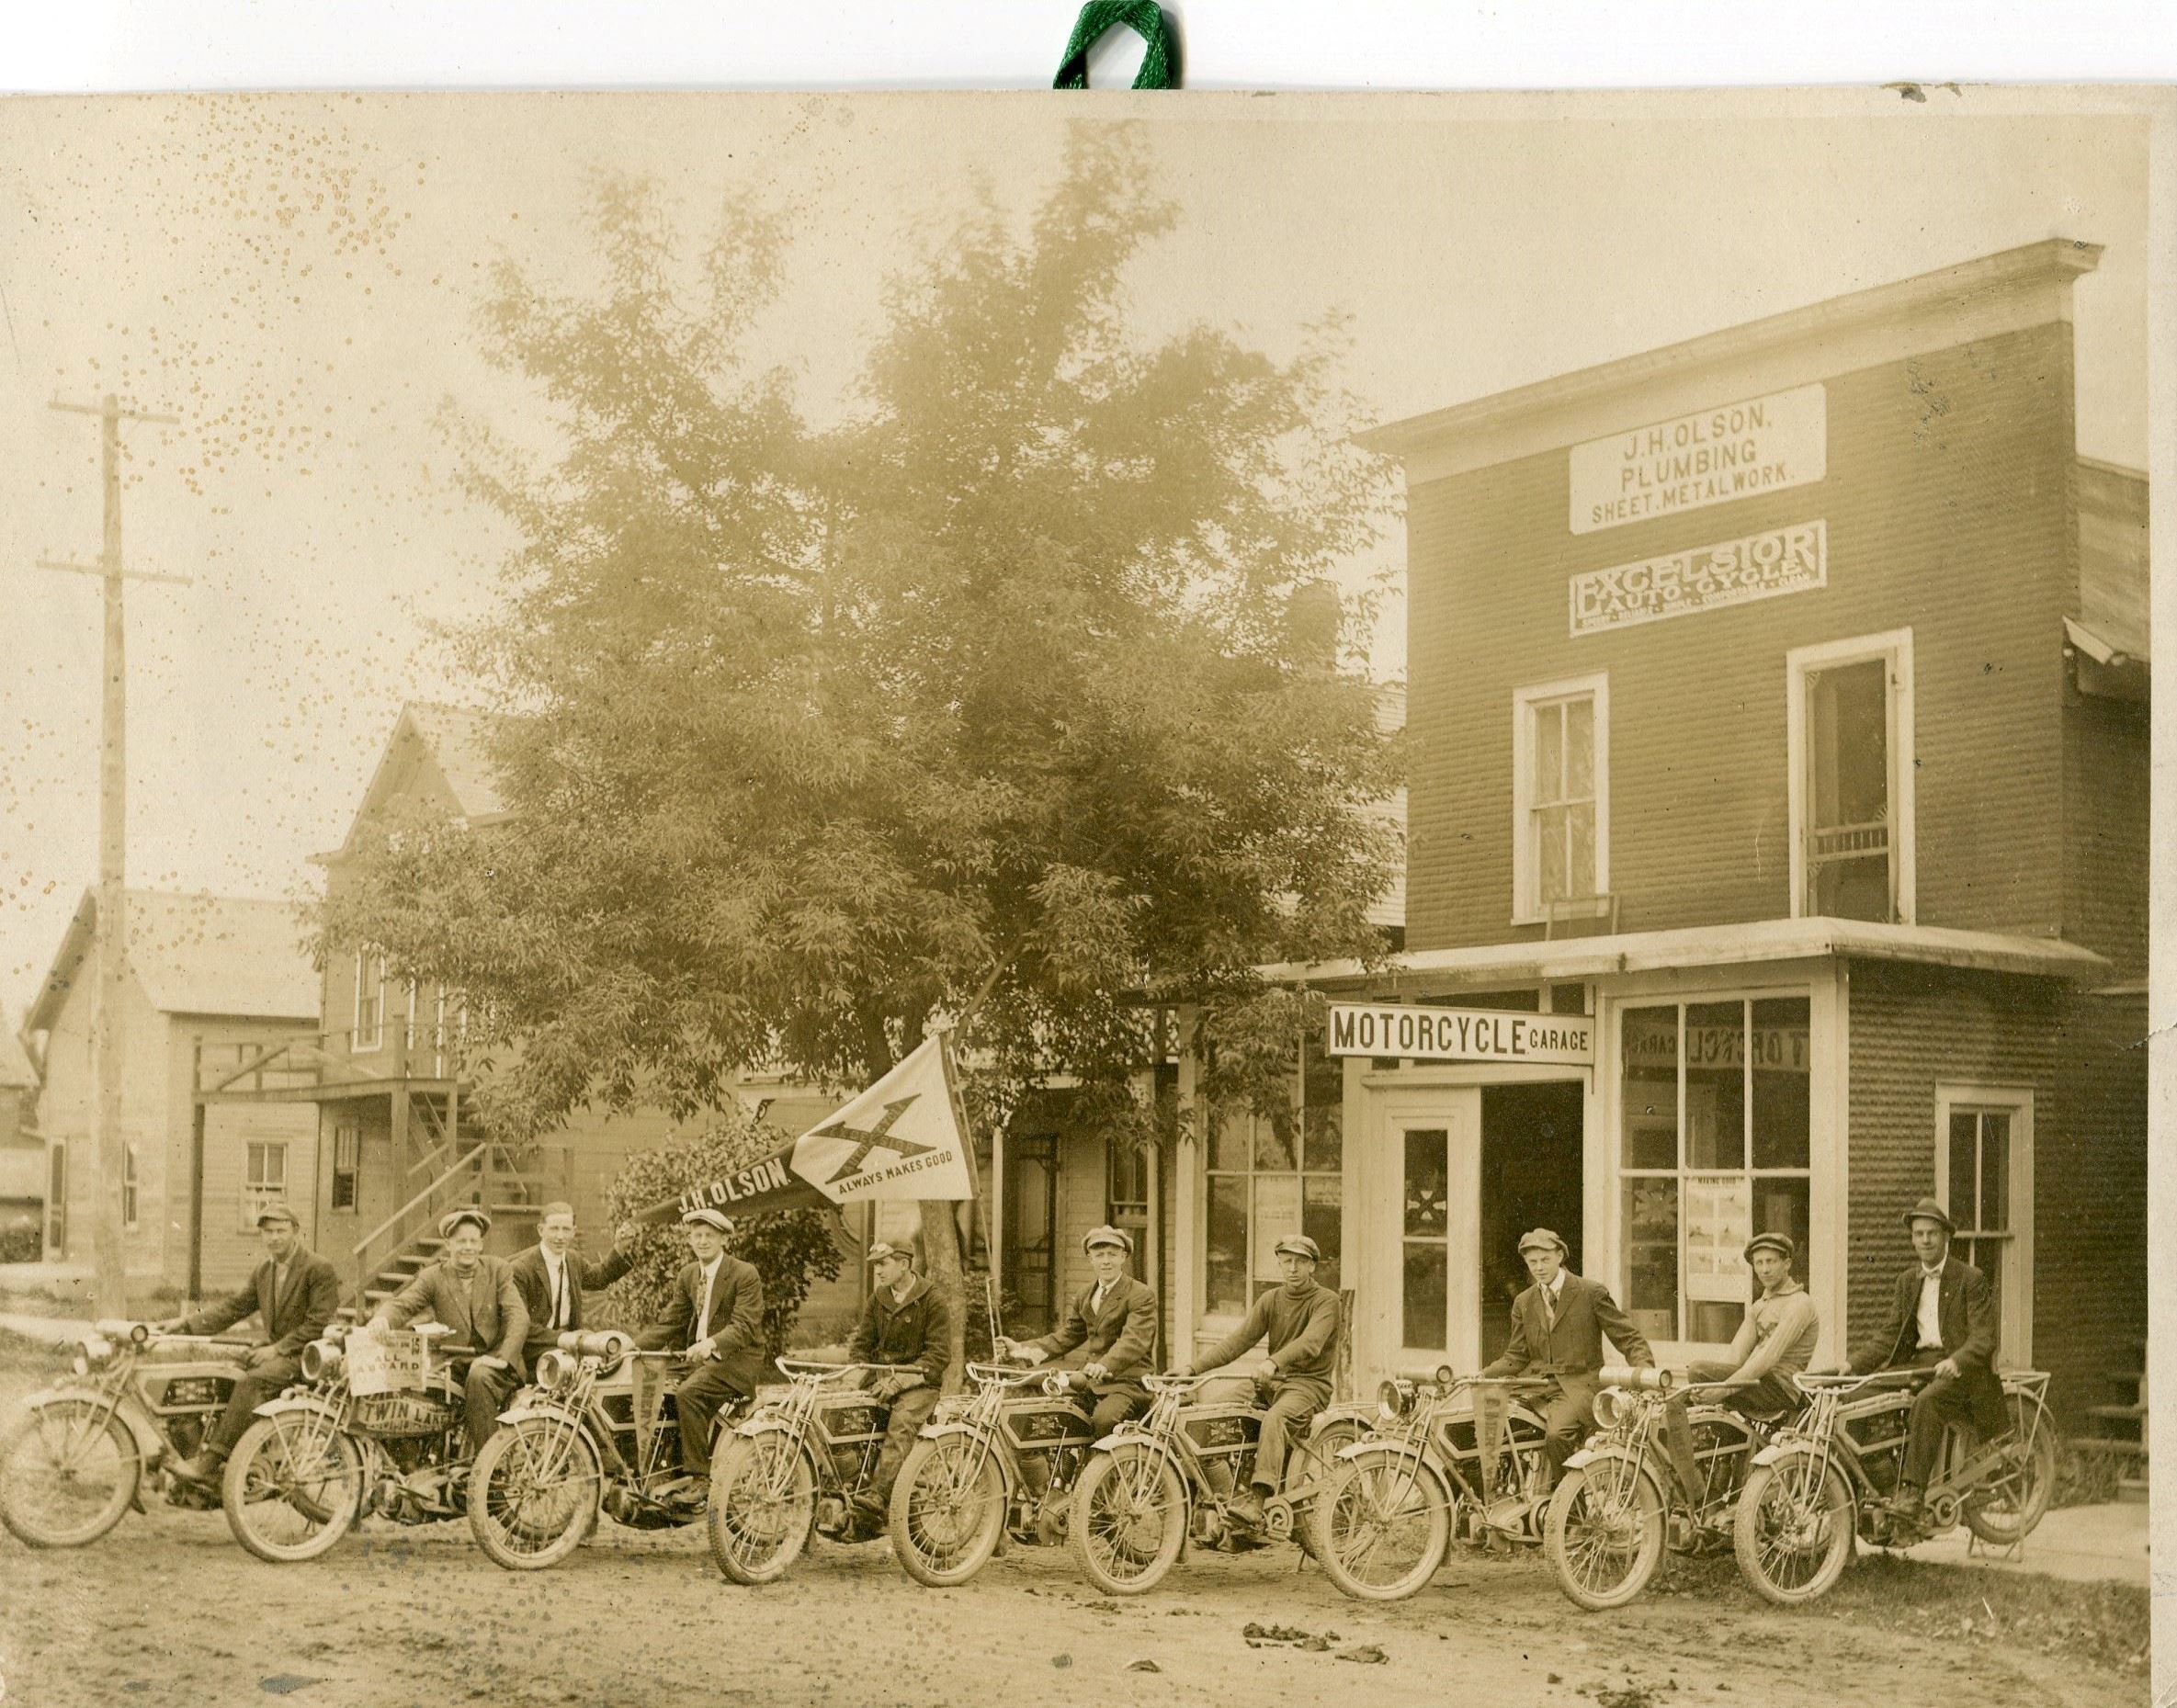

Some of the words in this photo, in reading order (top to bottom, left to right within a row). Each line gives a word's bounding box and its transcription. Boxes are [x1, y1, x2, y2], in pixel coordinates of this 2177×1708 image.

[1621, 438, 1756, 493] PLUMBING
[1577, 526, 1817, 619] EXCELSIOR
[1606, 557, 1804, 615] AUTO-CYCLE
[1333, 1010, 1526, 1056] MOTORCYCLE
[1529, 1028, 1589, 1052] GARAGE
[838, 1171, 883, 1194] ALWAYS
[886, 1159, 924, 1180] MAKES
[925, 1150, 953, 1168] GOOD
[365, 1402, 410, 1423] TWIN
